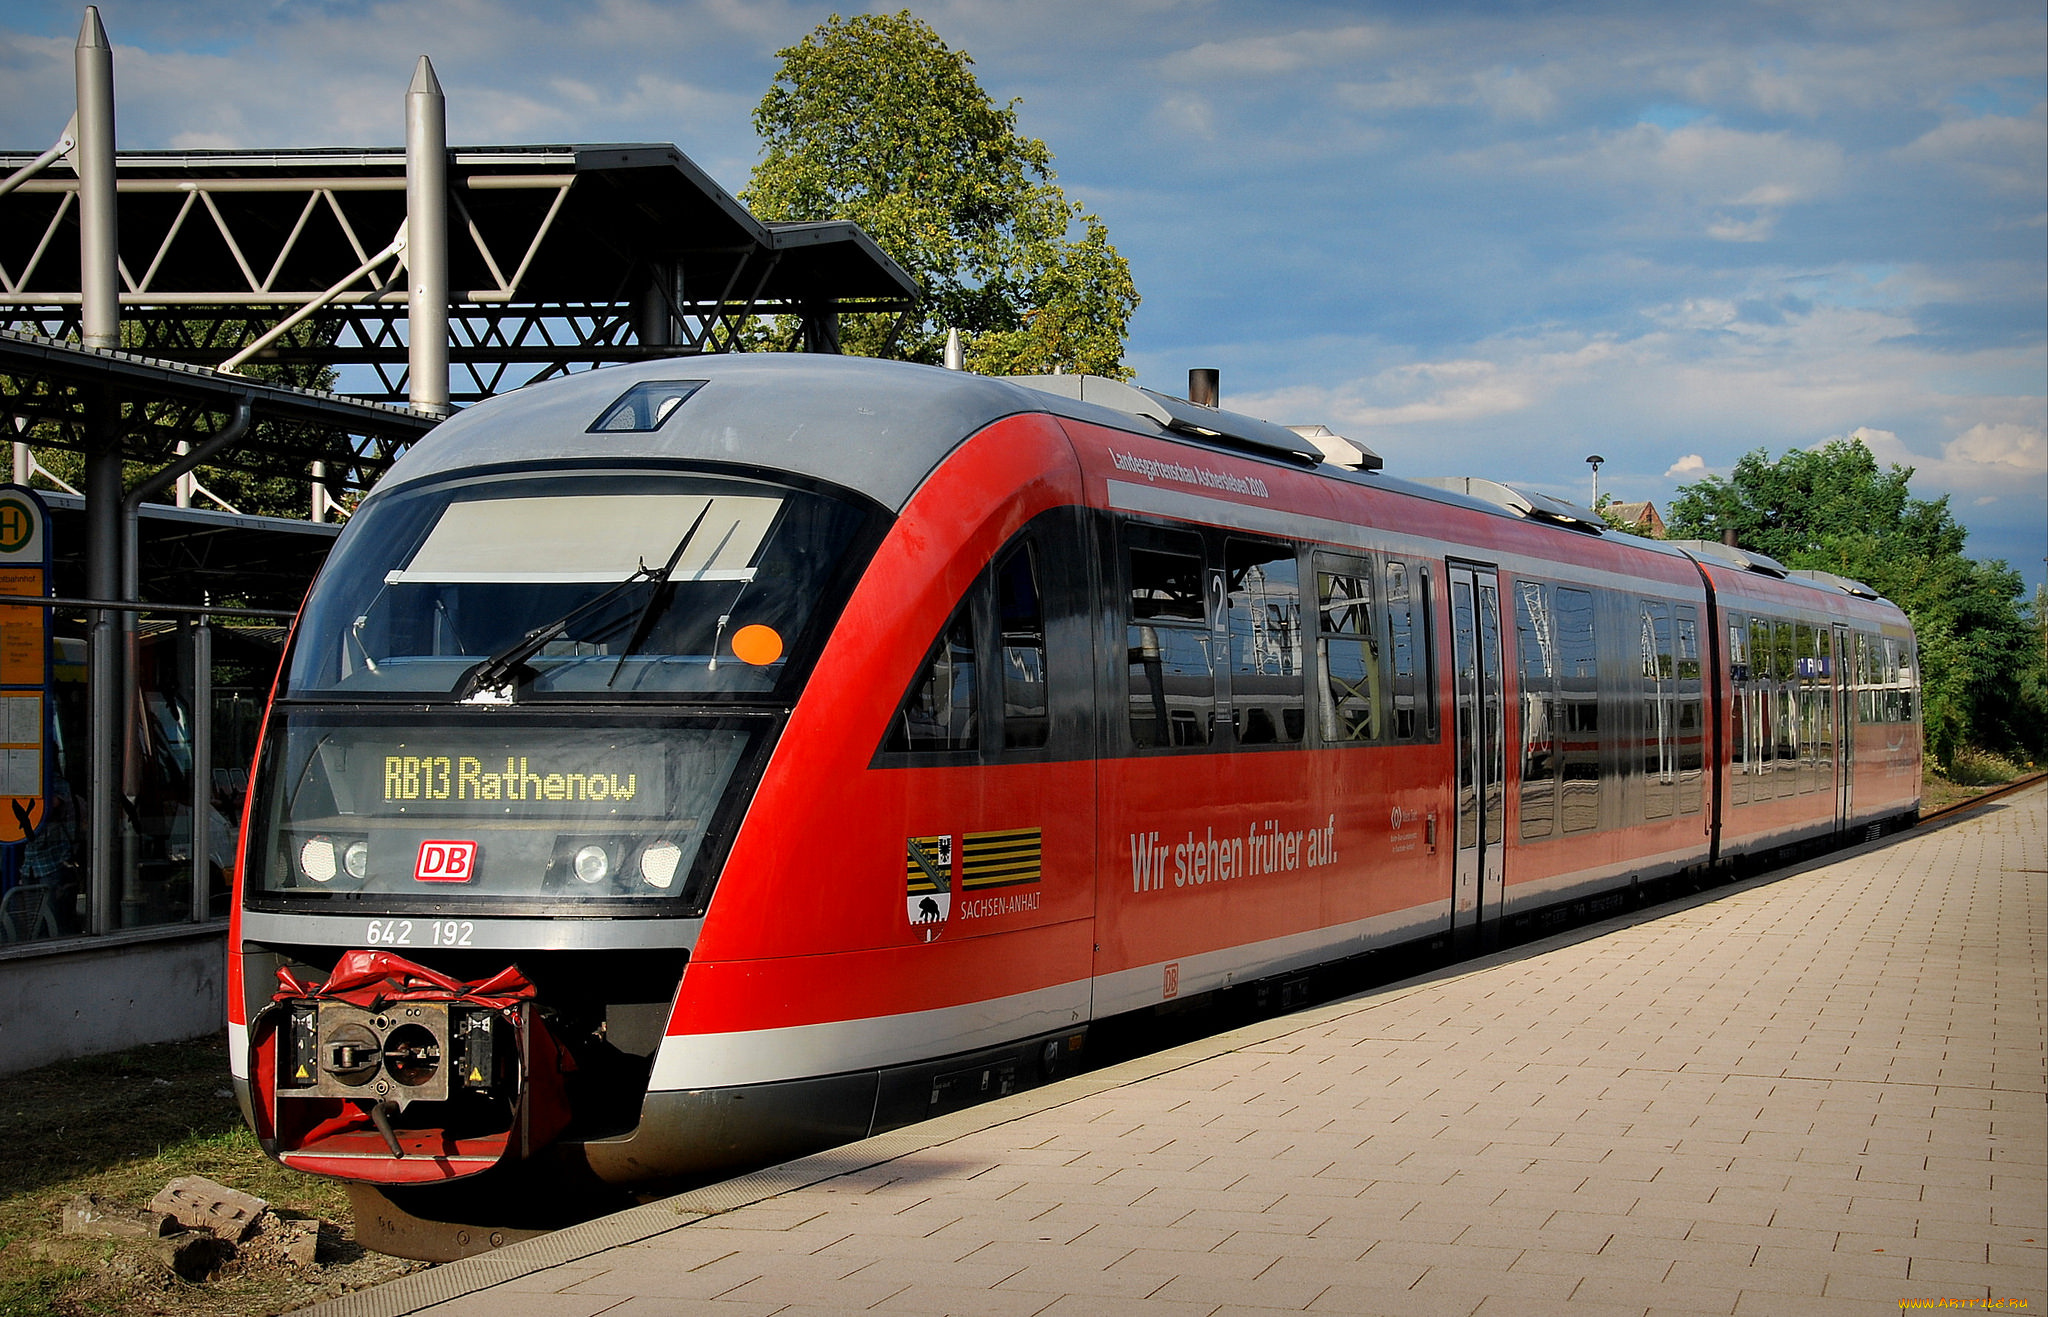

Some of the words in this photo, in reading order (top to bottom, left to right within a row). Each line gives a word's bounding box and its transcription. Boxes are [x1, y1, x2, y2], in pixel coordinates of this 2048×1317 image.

[1108, 447, 1199, 484] Landesgartenschau
[1194, 465, 1251, 495] Aschersleben
[1245, 476, 1269, 498] 2010
[0, 510, 19, 540] H
[1212, 574, 1226, 632] 2
[384, 756, 451, 800] RB13
[457, 756, 637, 801] Rathenow
[421, 846, 468, 876] DB
[1130, 831, 1169, 893] Wir
[1174, 826, 1243, 888] stehen
[1248, 819, 1304, 877] früher
[1307, 813, 1338, 868] auf.
[960, 891, 1041, 920] SACHSEN-ANHALT
[366, 919, 412, 946] 642
[431, 920, 475, 947] 192
